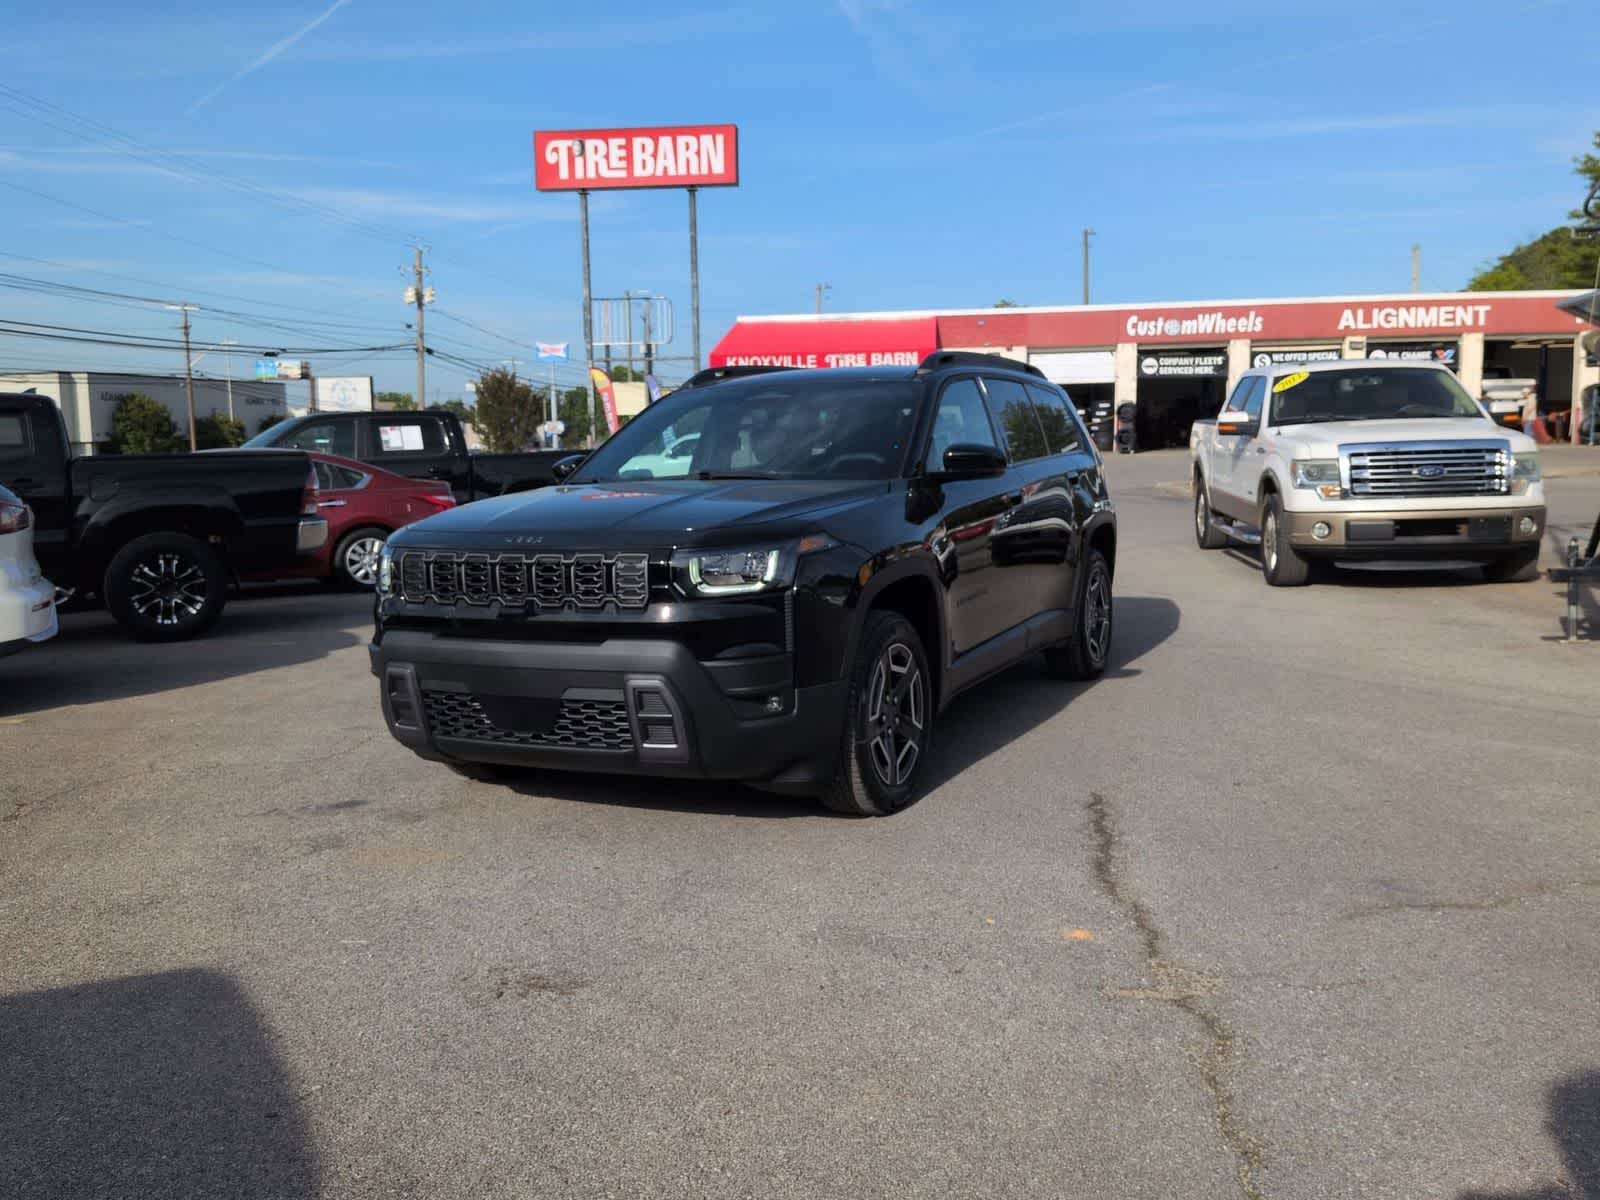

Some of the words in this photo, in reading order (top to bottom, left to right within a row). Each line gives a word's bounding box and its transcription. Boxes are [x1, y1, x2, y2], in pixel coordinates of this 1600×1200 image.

[632, 134, 725, 178] BARN
[1337, 305, 1491, 330] ALIGNMENT
[726, 354, 817, 368] KNOXVILLE
[871, 351, 917, 366] BARN
[1159, 357, 1194, 366] COMPANY
